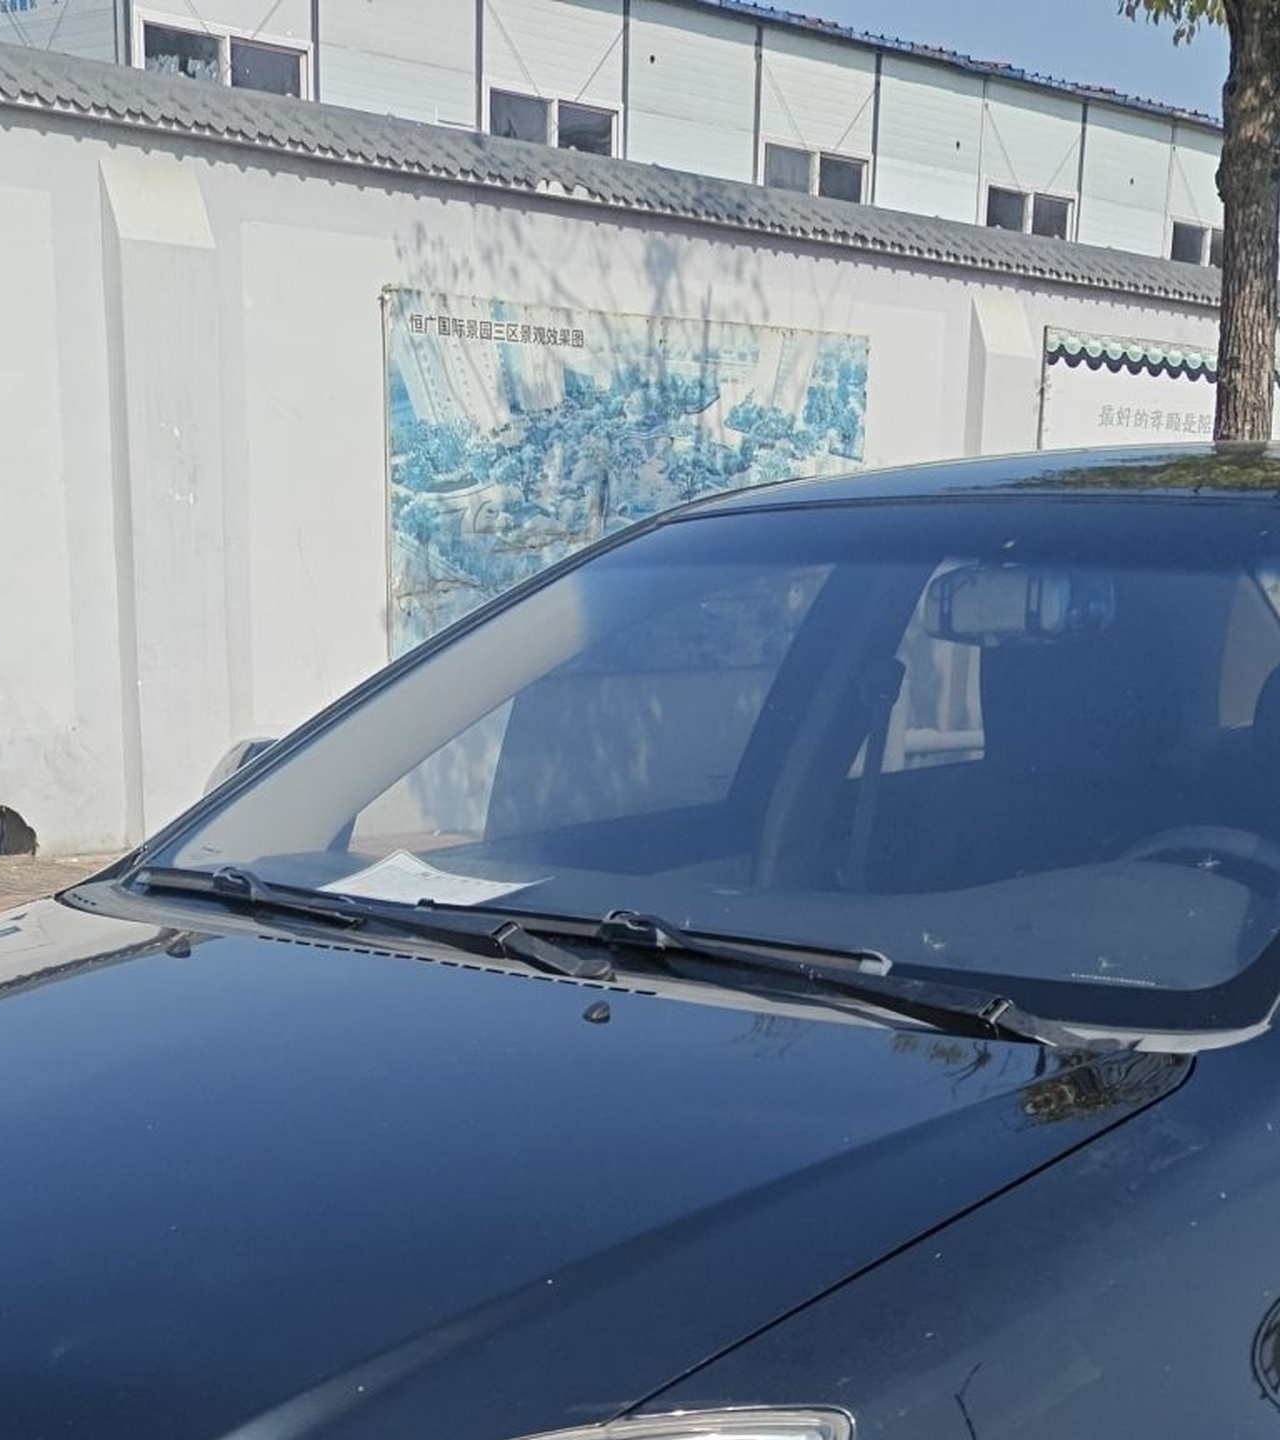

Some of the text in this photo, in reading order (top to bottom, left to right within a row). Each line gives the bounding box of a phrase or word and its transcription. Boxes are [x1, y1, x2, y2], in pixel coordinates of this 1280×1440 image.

[410, 313, 584, 348] 恒广国际景园三区景观效果图
